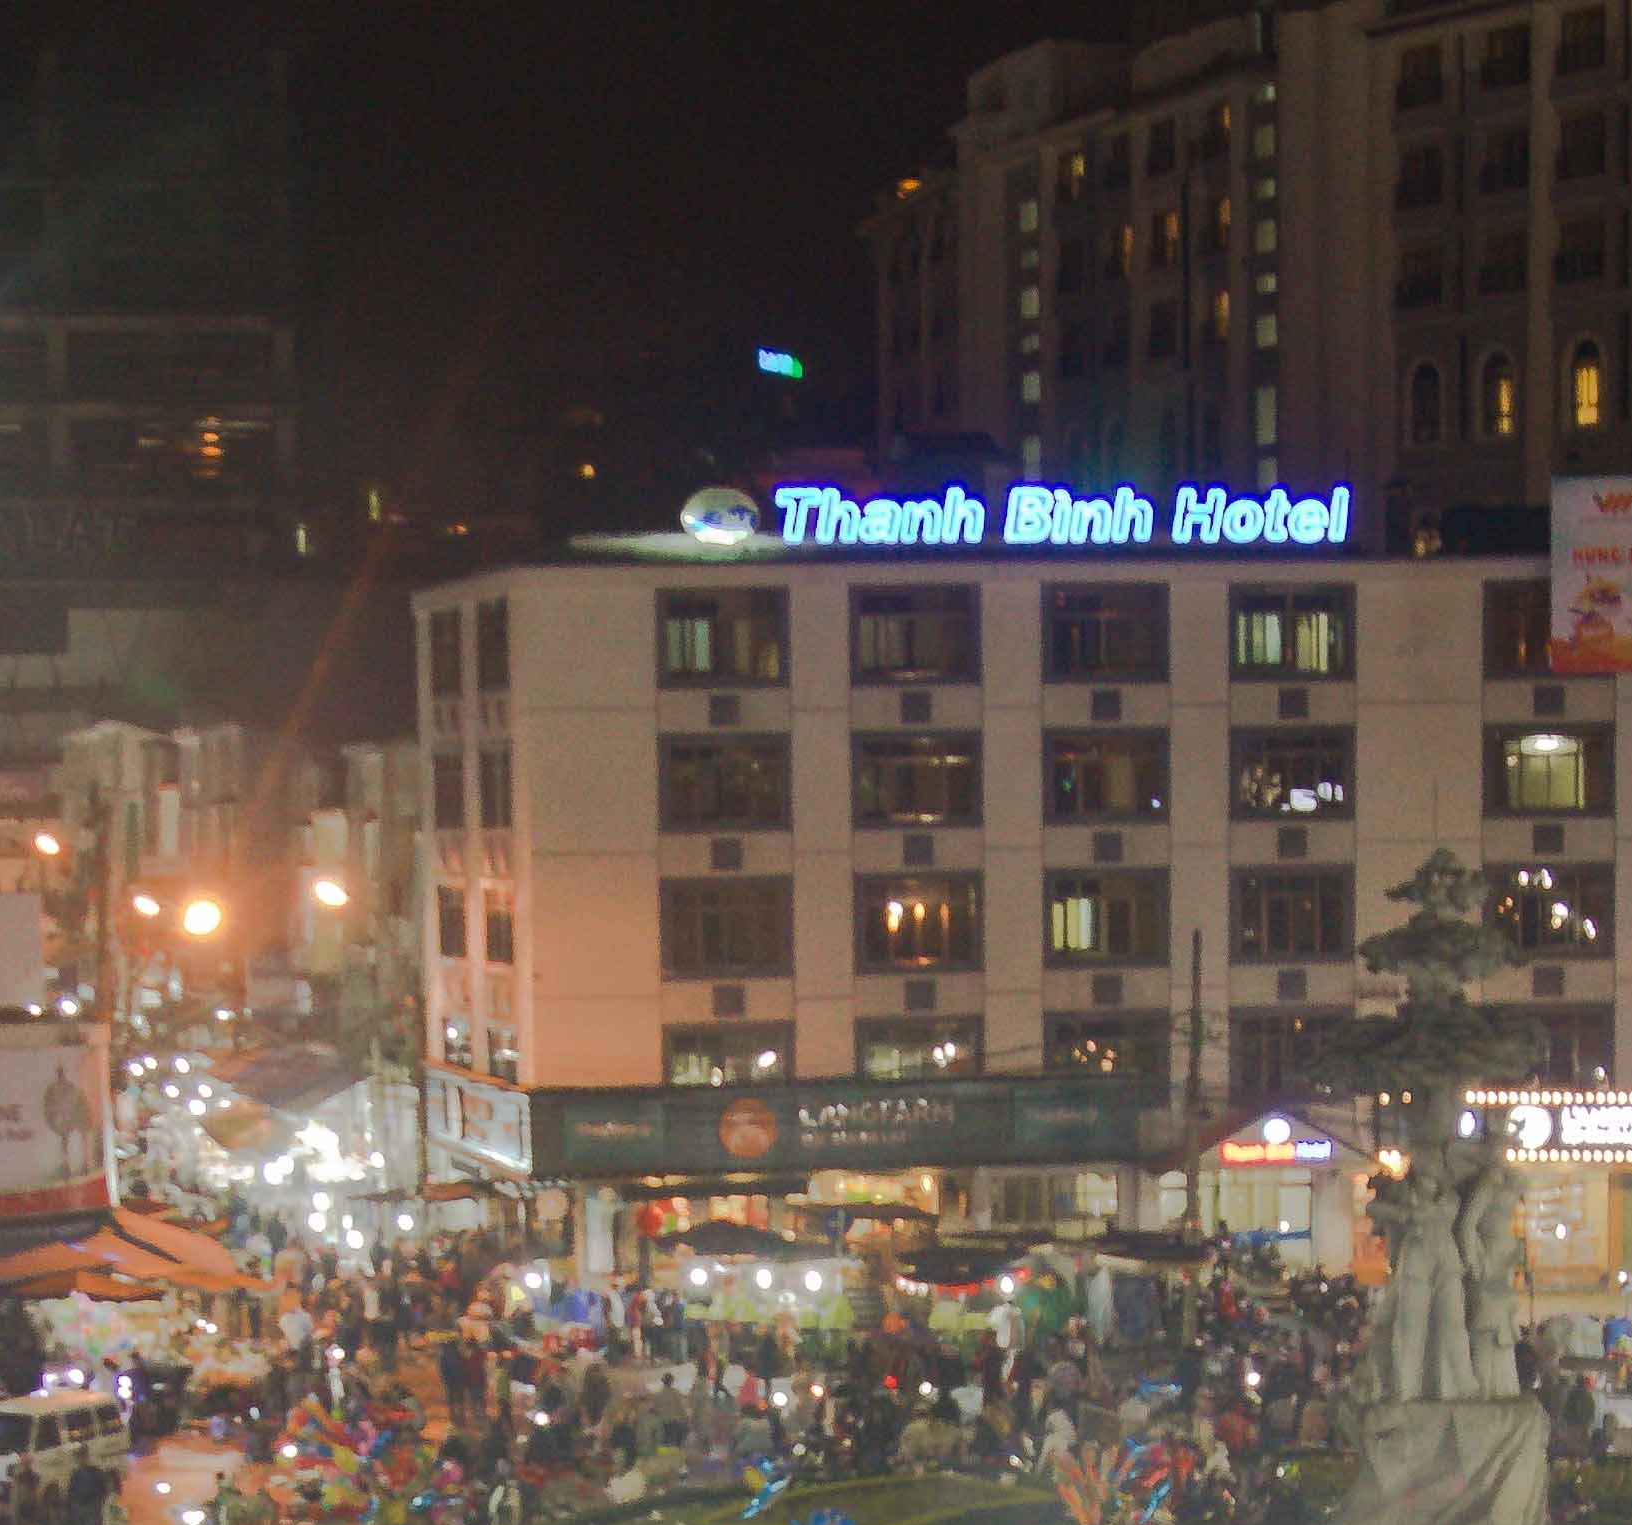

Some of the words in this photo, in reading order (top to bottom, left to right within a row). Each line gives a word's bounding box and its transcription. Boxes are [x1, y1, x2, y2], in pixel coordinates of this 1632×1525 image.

[774, 486, 986, 546] Thanh
[1002, 486, 1155, 545] Bình
[1170, 486, 1351, 545] Hotel
